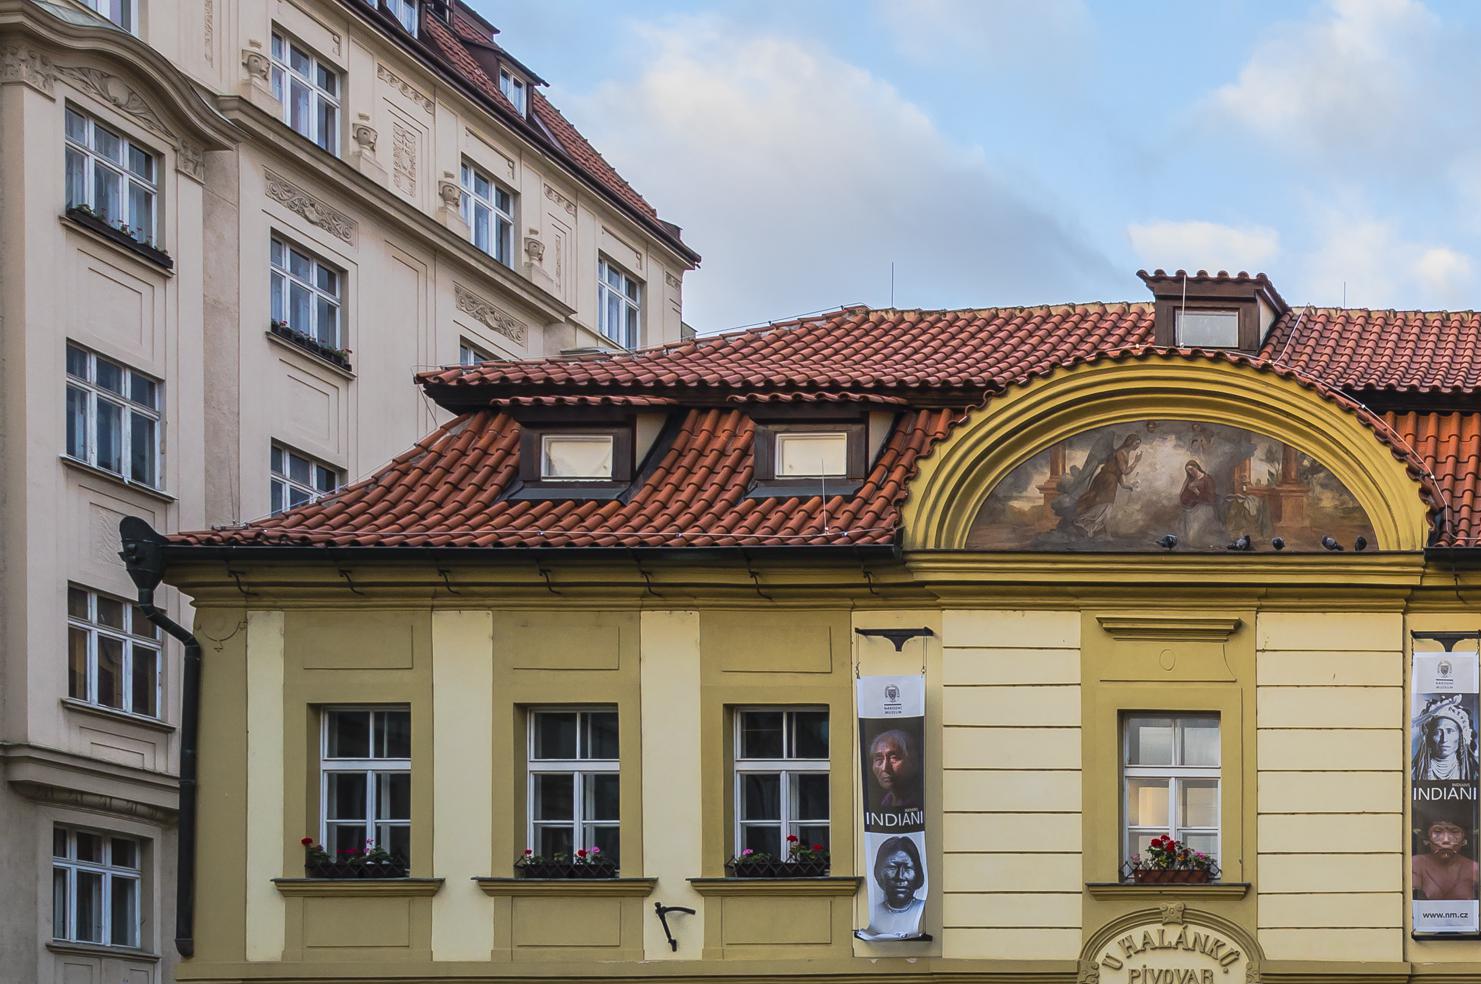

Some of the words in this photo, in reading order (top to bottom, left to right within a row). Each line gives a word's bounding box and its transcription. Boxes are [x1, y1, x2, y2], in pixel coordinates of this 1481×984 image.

[1413, 787, 1477, 800] INDIANI
[866, 810, 923, 827] INDIANI
[1101, 952, 1124, 971] U
